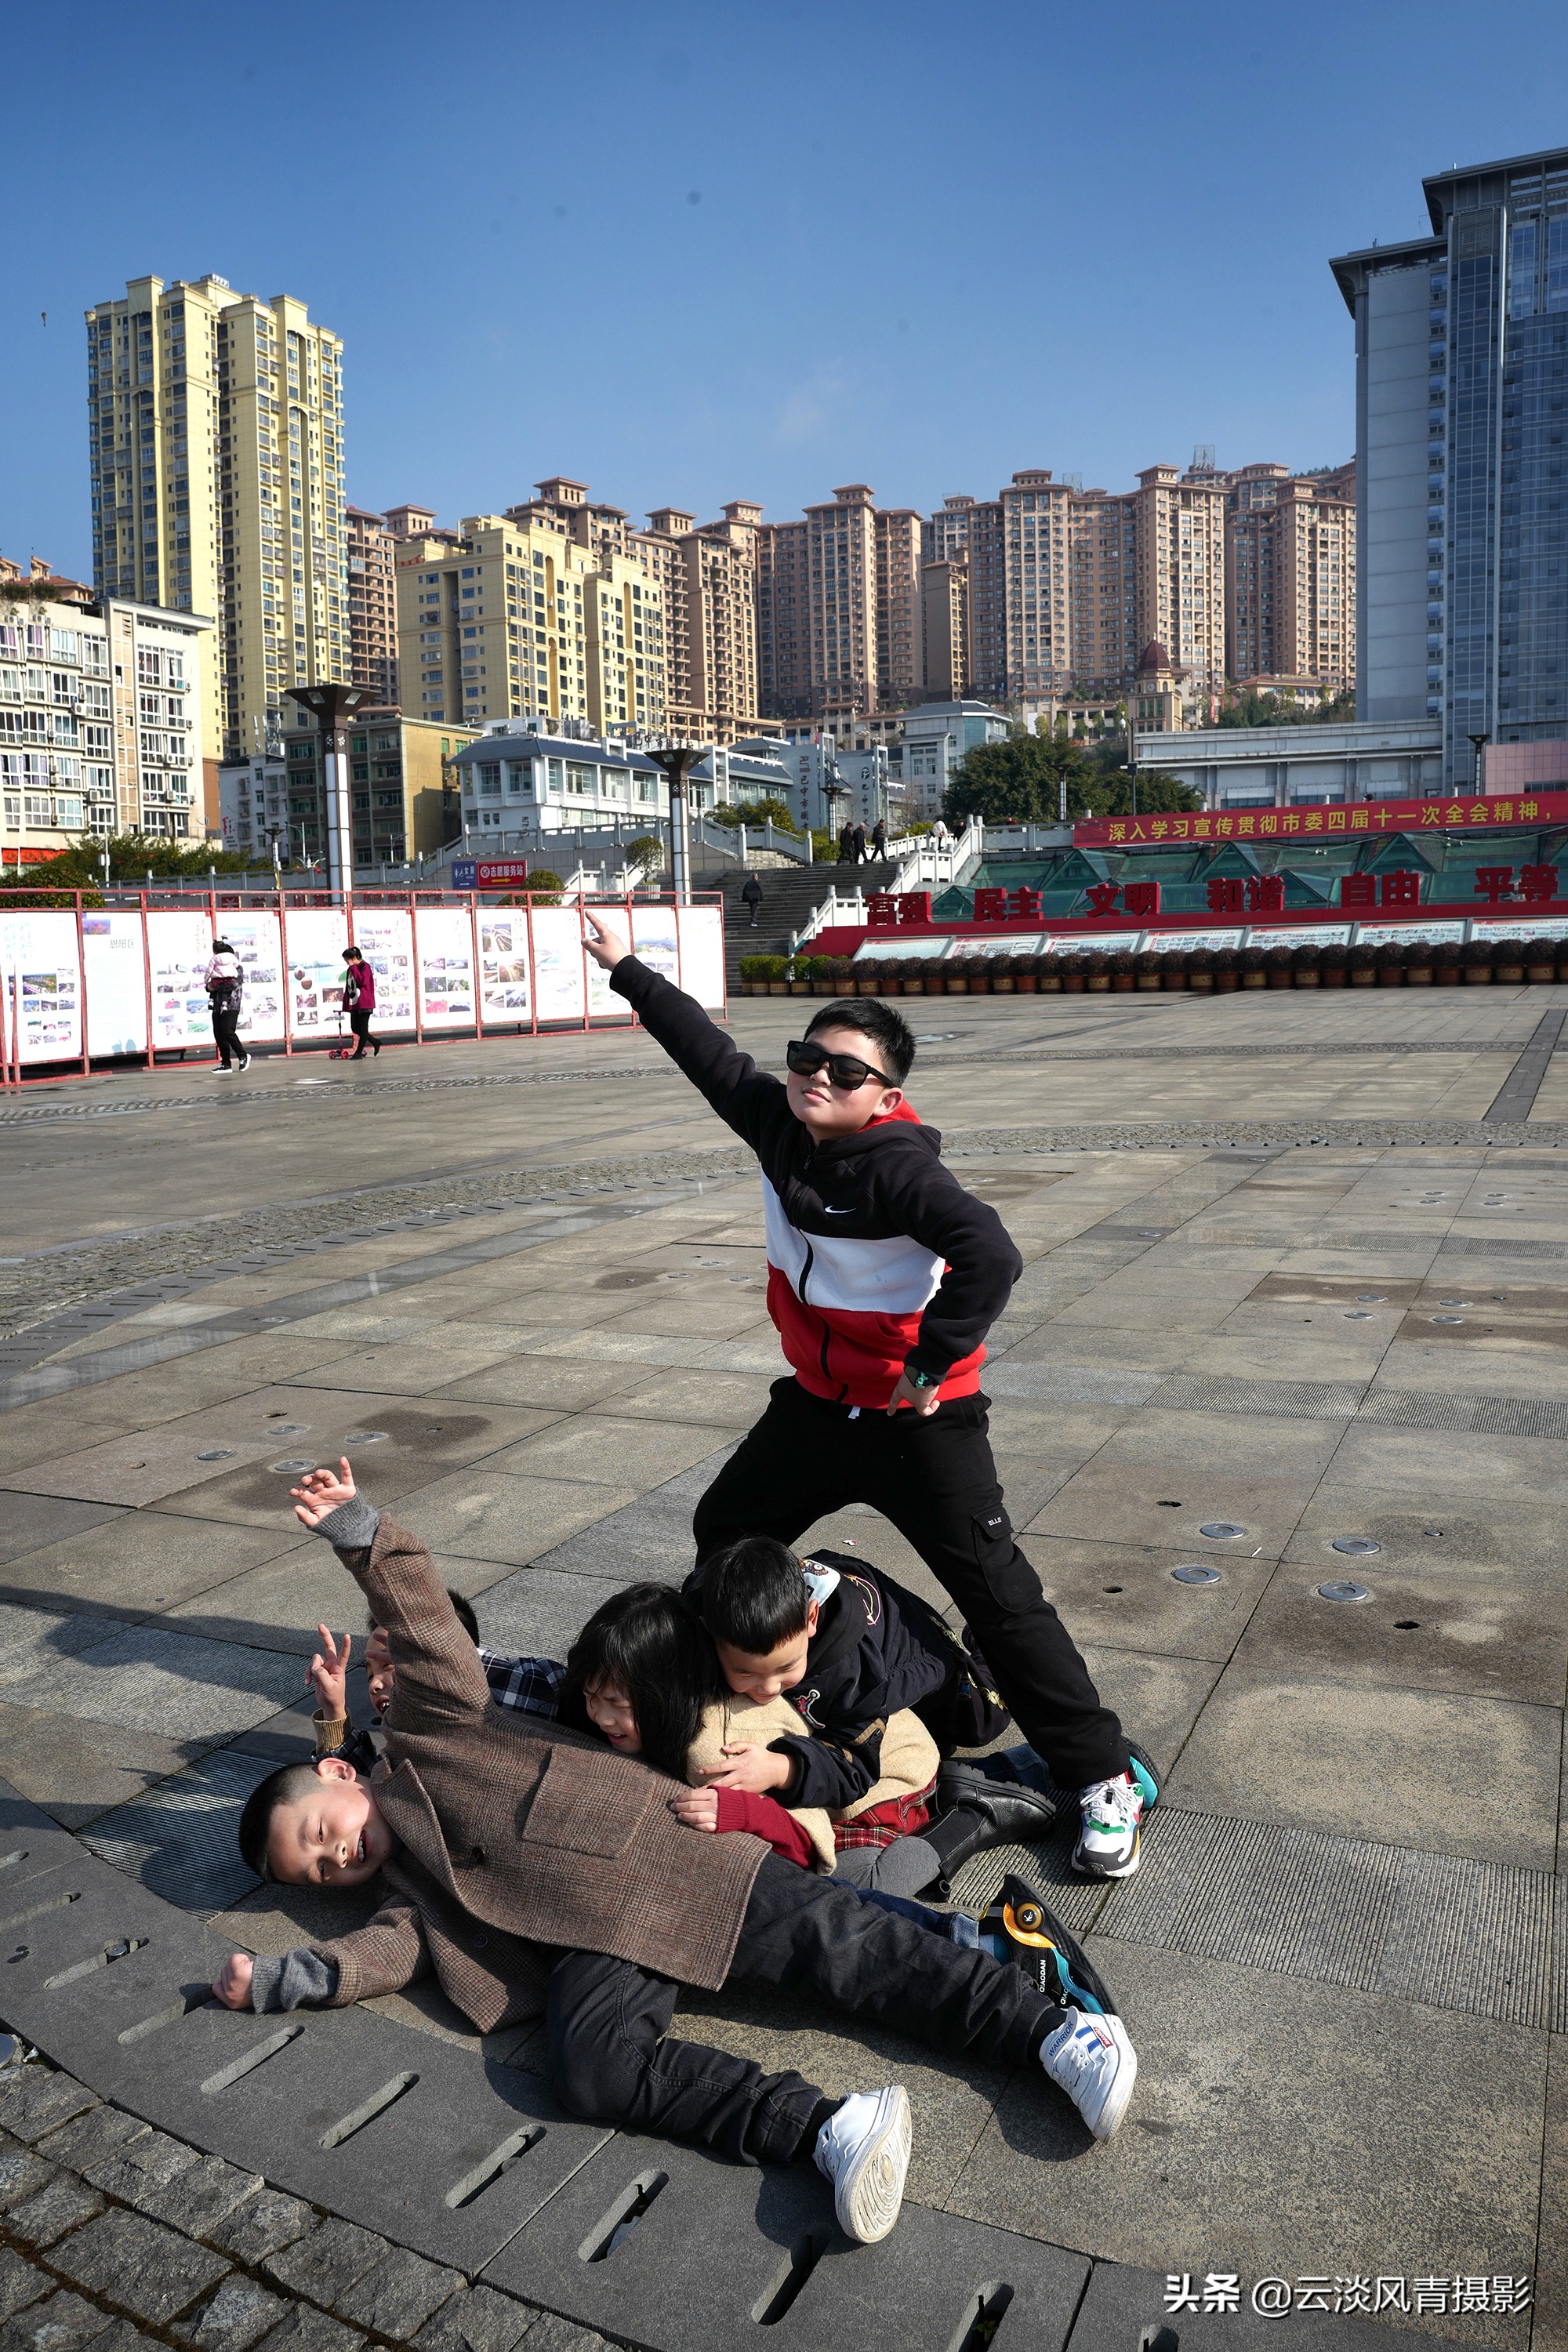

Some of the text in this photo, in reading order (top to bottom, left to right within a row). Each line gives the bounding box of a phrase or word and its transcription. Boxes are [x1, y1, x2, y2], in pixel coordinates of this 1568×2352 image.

[490, 865, 524, 877] 志愿服务站
[865, 863, 1559, 926] 富强 民主 文明 和谐 自由 平等
[988, 1516, 1002, 1526] ELLE
[1048, 2021, 1074, 2056] WARRIOR
